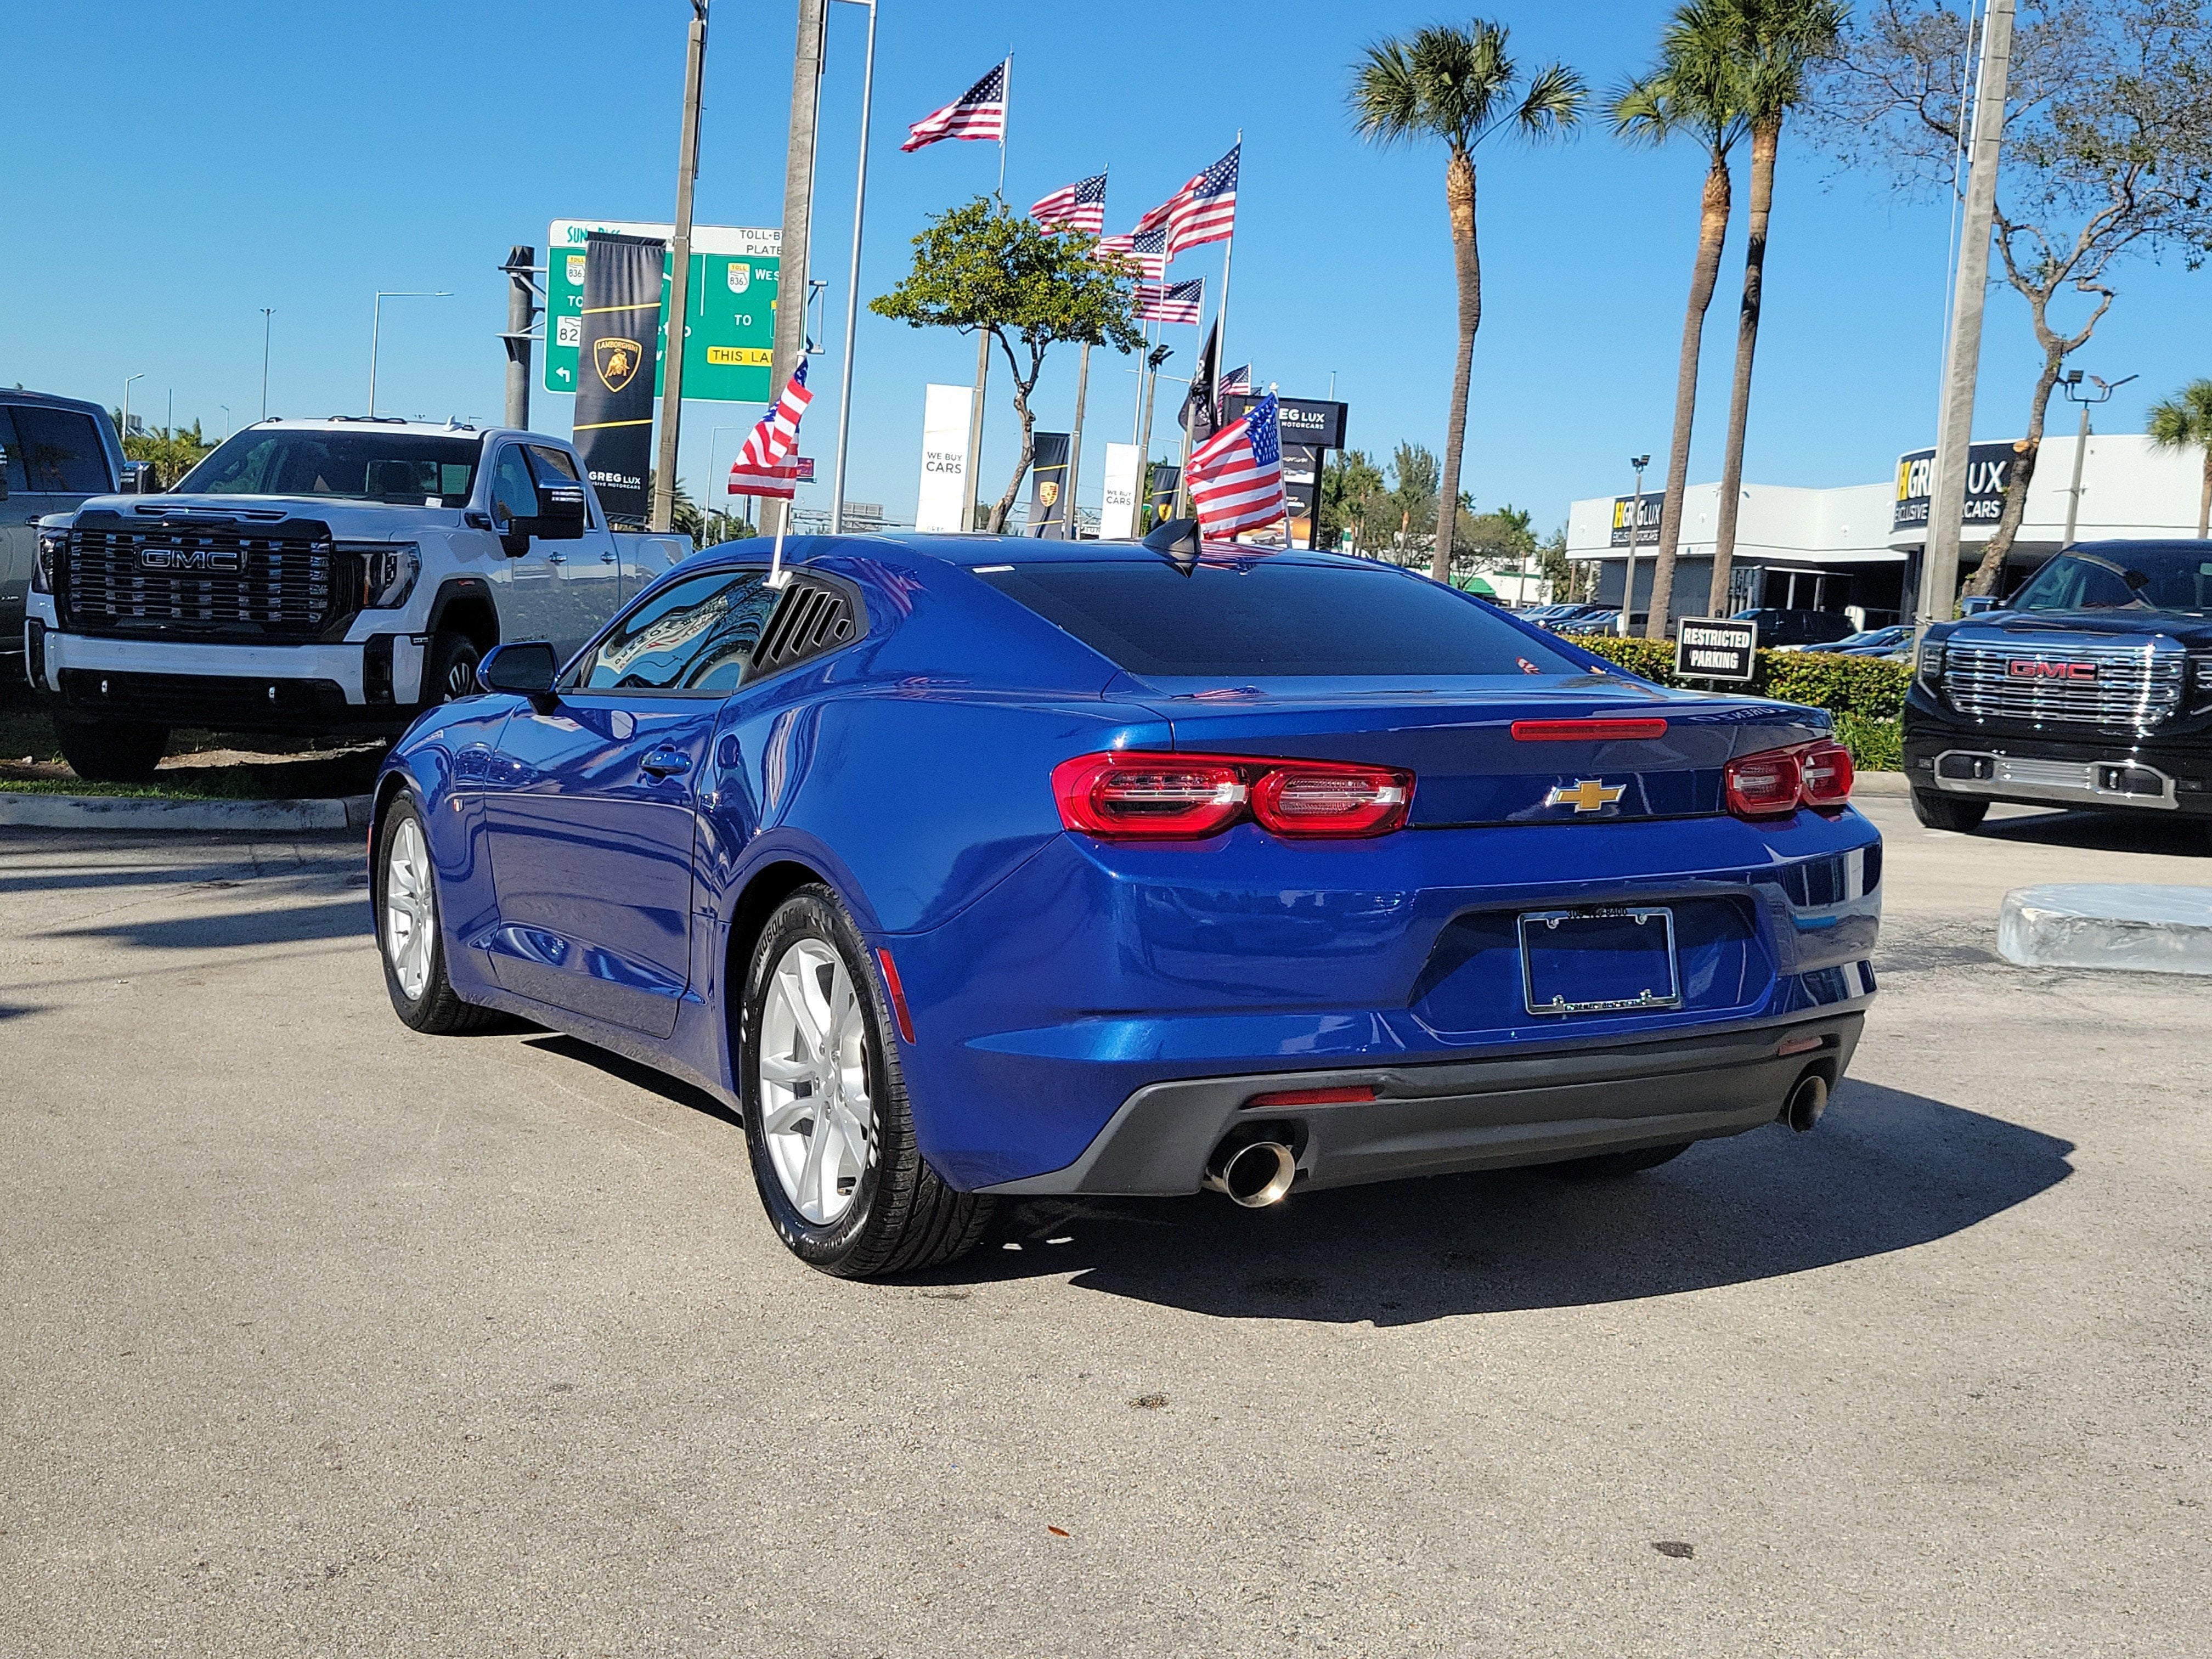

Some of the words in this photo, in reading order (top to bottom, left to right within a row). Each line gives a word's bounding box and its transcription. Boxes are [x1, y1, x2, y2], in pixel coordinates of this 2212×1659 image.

[740, 230, 783, 240] TOLL-B
[730, 277, 743, 285] 836
[755, 269, 779, 281] WES
[567, 296, 583, 307] TO
[734, 314, 752, 325] TO
[560, 329, 578, 341] 82
[598, 341, 637, 353] LAMBORGHINI
[713, 349, 743, 361] THIS
[751, 352, 772, 363] LA
[1279, 408, 1300, 421] EG
[1301, 413, 1325, 422] LUX
[1282, 421, 1324, 430] MOTORCARS
[927, 452, 943, 460] WE
[926, 461, 962, 473] CARS
[623, 476, 641, 484] LUX
[1897, 458, 1937, 501] HGR
[1968, 460, 2007, 494] UX
[1106, 496, 1131, 506] CARS
[1613, 500, 1647, 528] HGRG
[1962, 500, 2001, 518] CARS
[142, 549, 237, 570] GMC
[1683, 628, 1750, 648] RESTRICTED
[1690, 650, 1739, 669] PARKING
[2011, 661, 2096, 680] GMC
